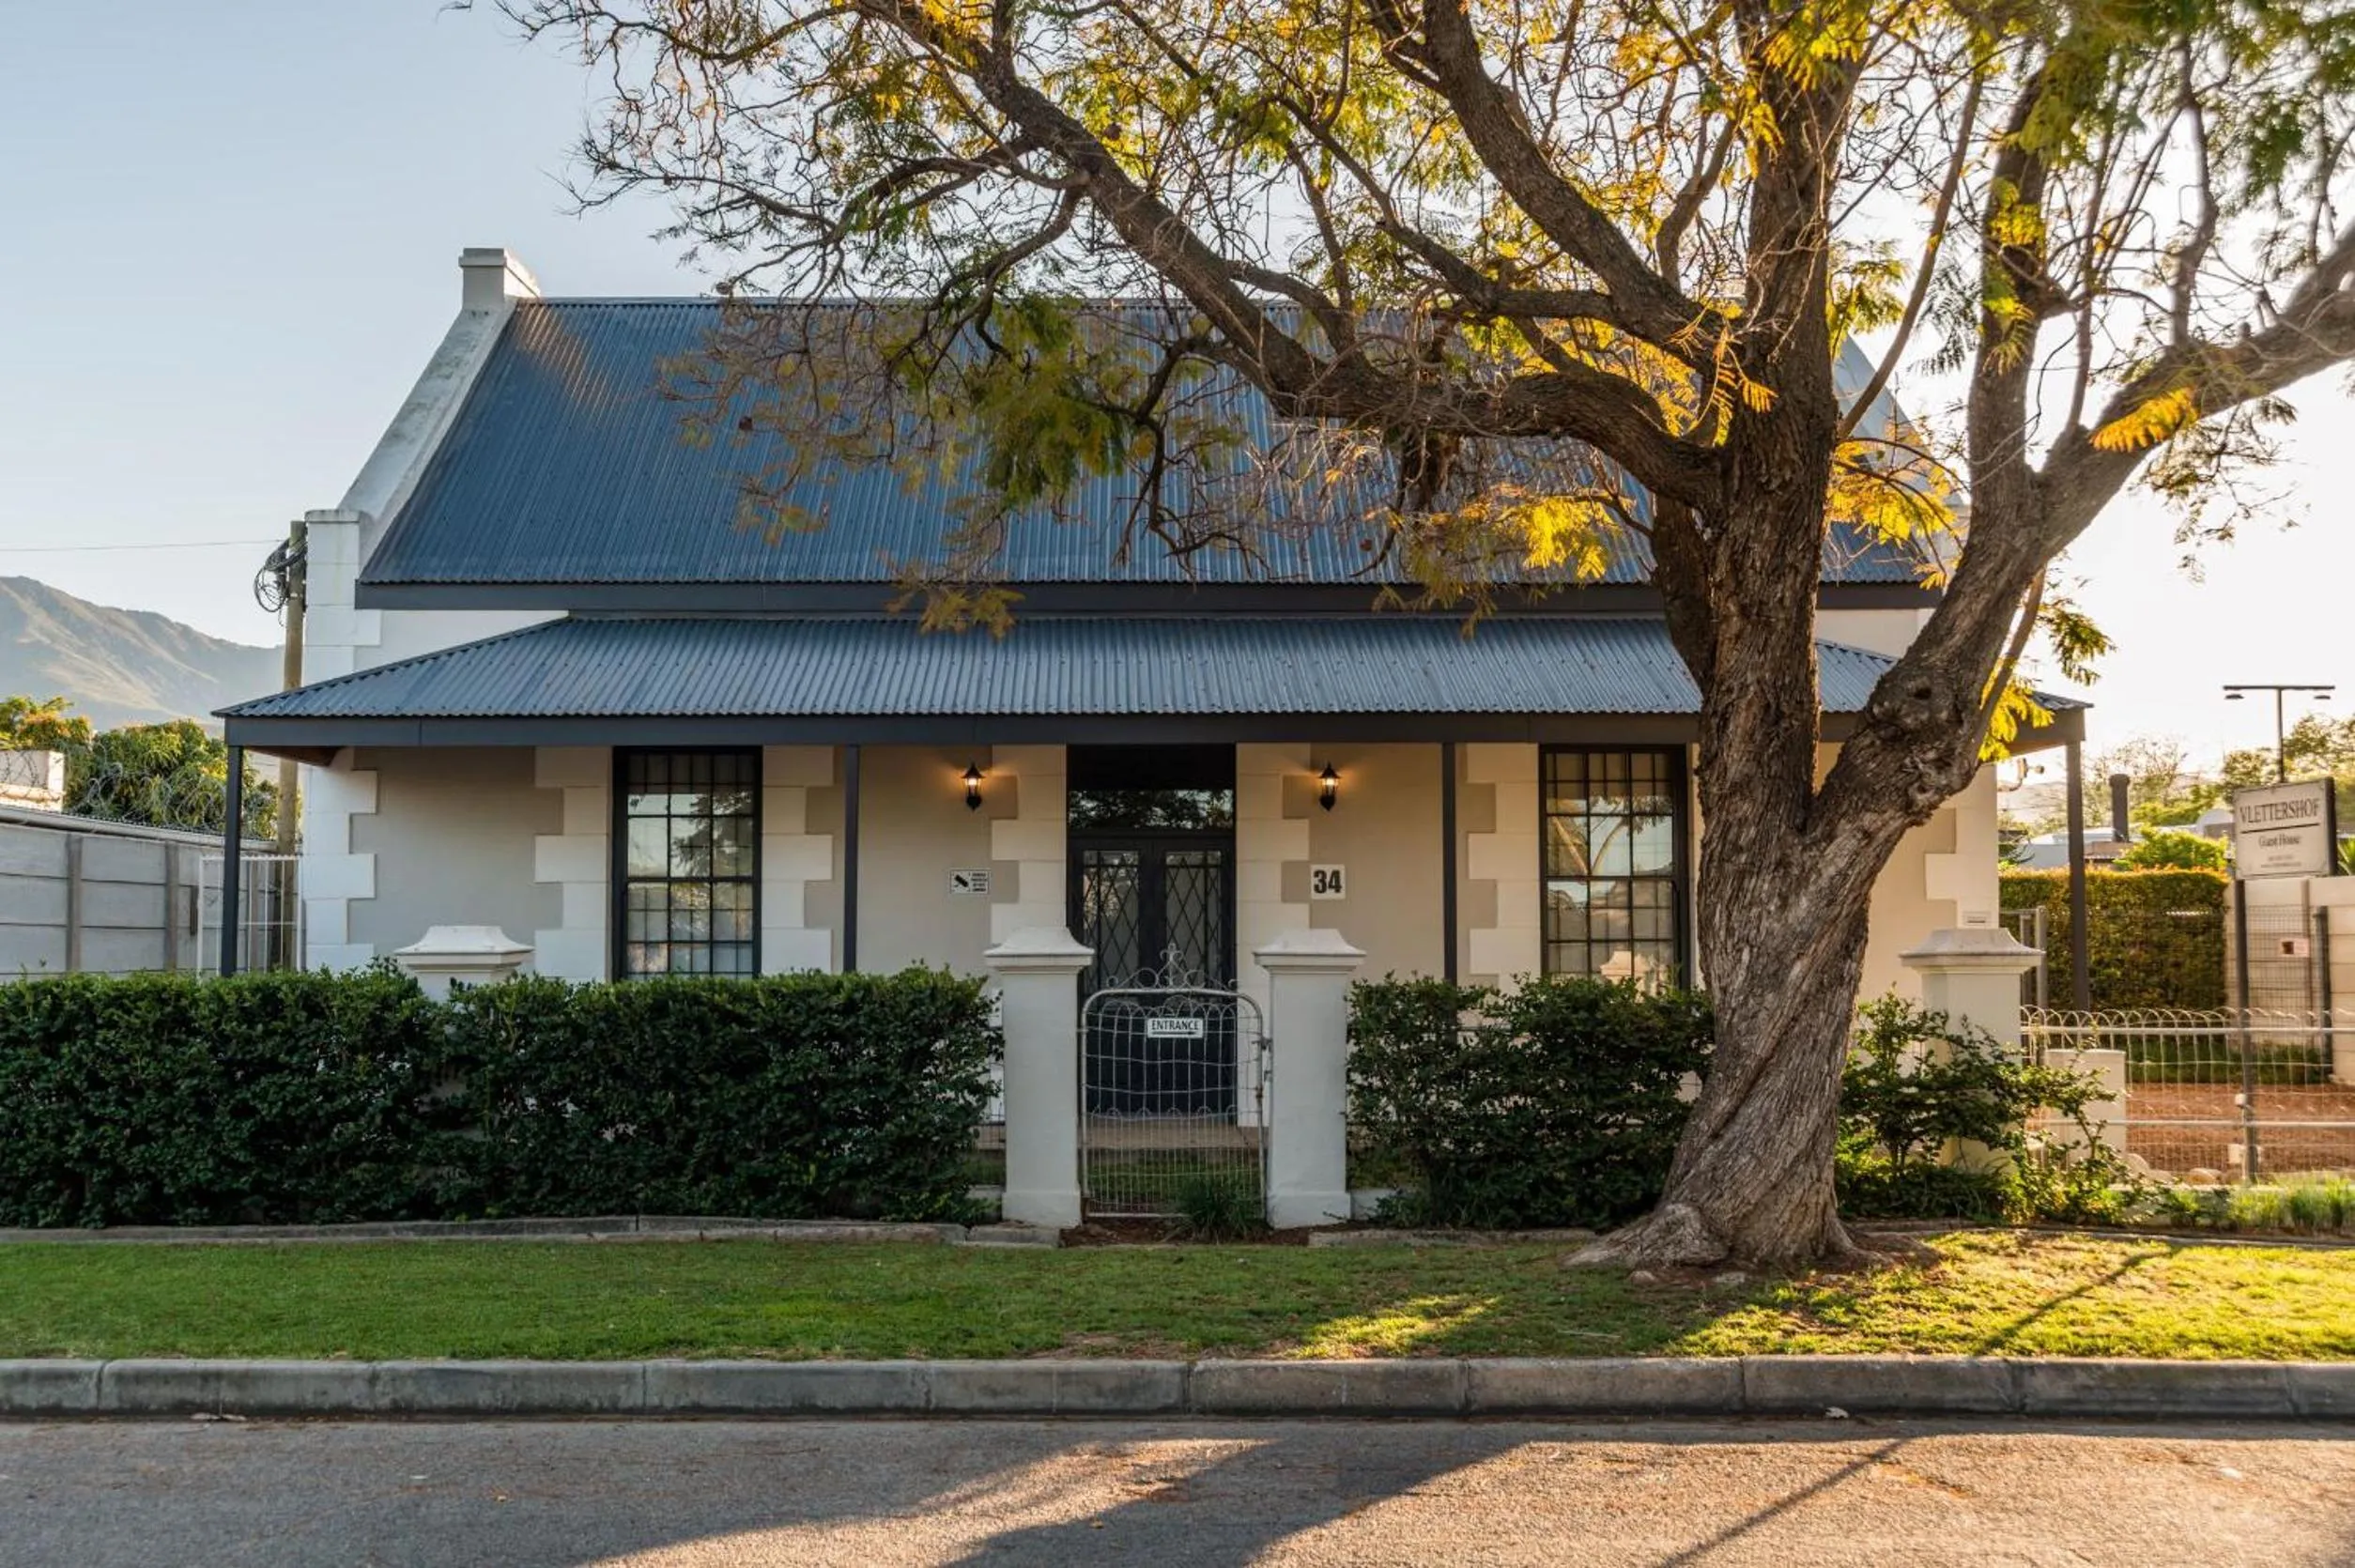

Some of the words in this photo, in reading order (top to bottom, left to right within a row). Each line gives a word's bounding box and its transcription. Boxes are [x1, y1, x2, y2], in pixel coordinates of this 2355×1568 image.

[2240, 798, 2319, 823] VLETTERSHOF
[1314, 869, 1342, 894] 34
[1151, 1020, 1198, 1030] ENTRANCE
